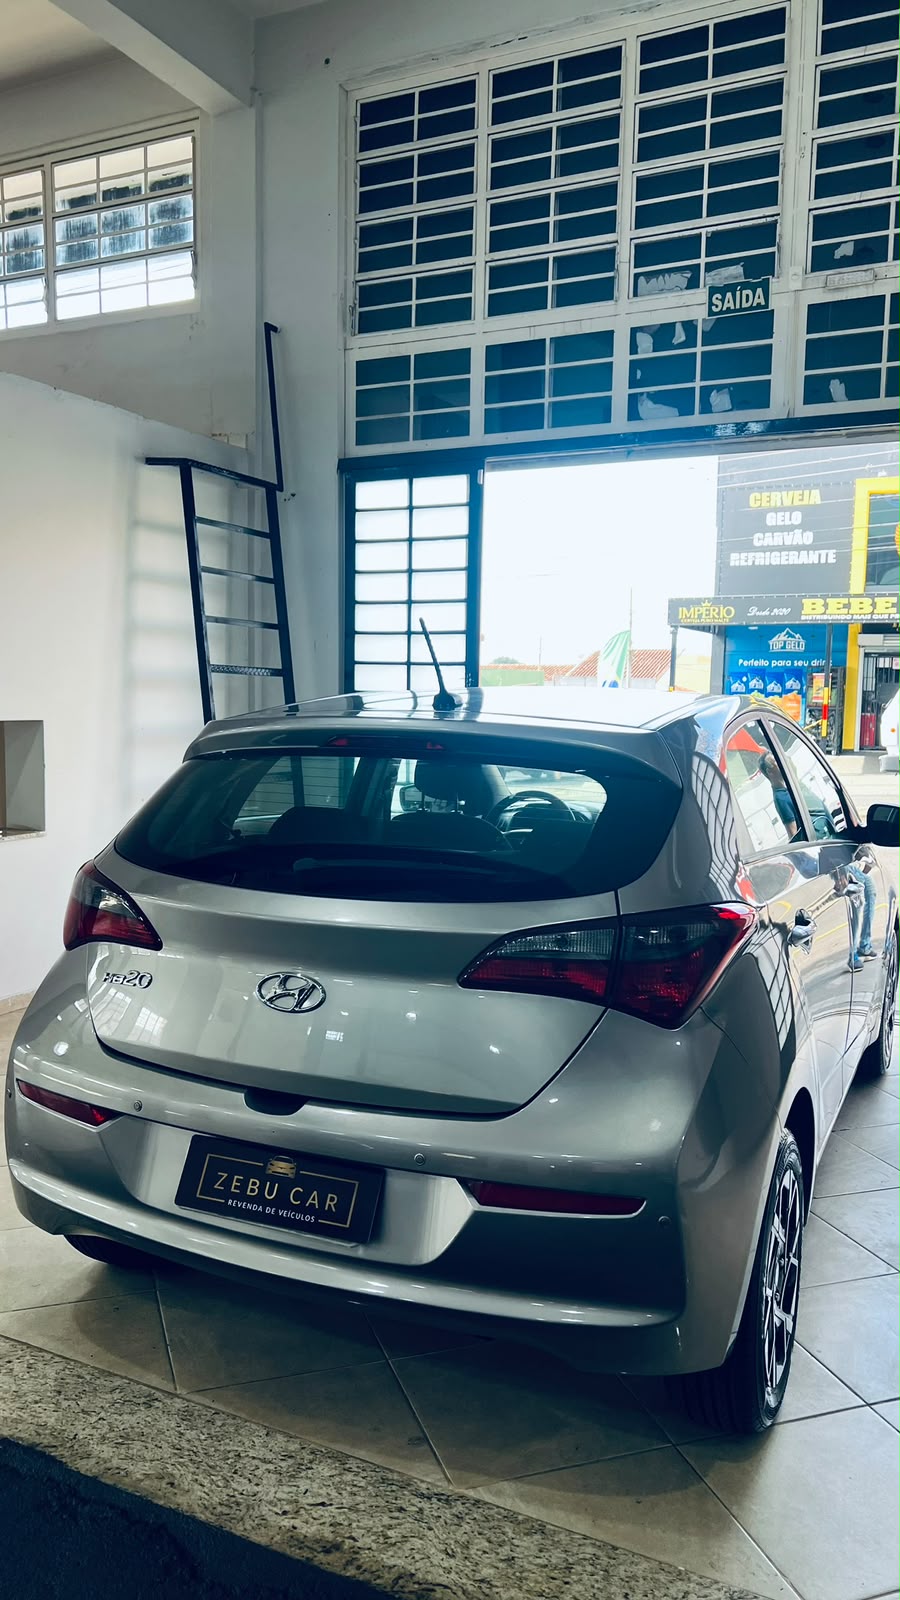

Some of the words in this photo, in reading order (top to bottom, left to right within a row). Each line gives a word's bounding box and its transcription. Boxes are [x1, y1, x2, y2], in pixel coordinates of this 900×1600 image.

[711, 286, 766, 313] SAÍDA
[749, 489, 822, 509] CERVEJA
[765, 511, 802, 526] GELO
[753, 529, 814, 547] CARVÃO
[729, 549, 837, 567] REFRIGERANTE
[747, 606, 770, 616] Desde
[770, 606, 791, 616] 2020
[769, 641, 785, 650] TOP
[786, 641, 805, 650] GELO
[738, 659, 770, 667] Perfeito
[771, 660, 792, 668] para
[103, 970, 153, 989] HB20
[213, 1172, 279, 1200] ZEBU
[289, 1187, 339, 1213] CAR
[227, 1199, 263, 1214] REVENDA
[265, 1206, 276, 1215] DE
[278, 1208, 316, 1223] VEÍCULOS
